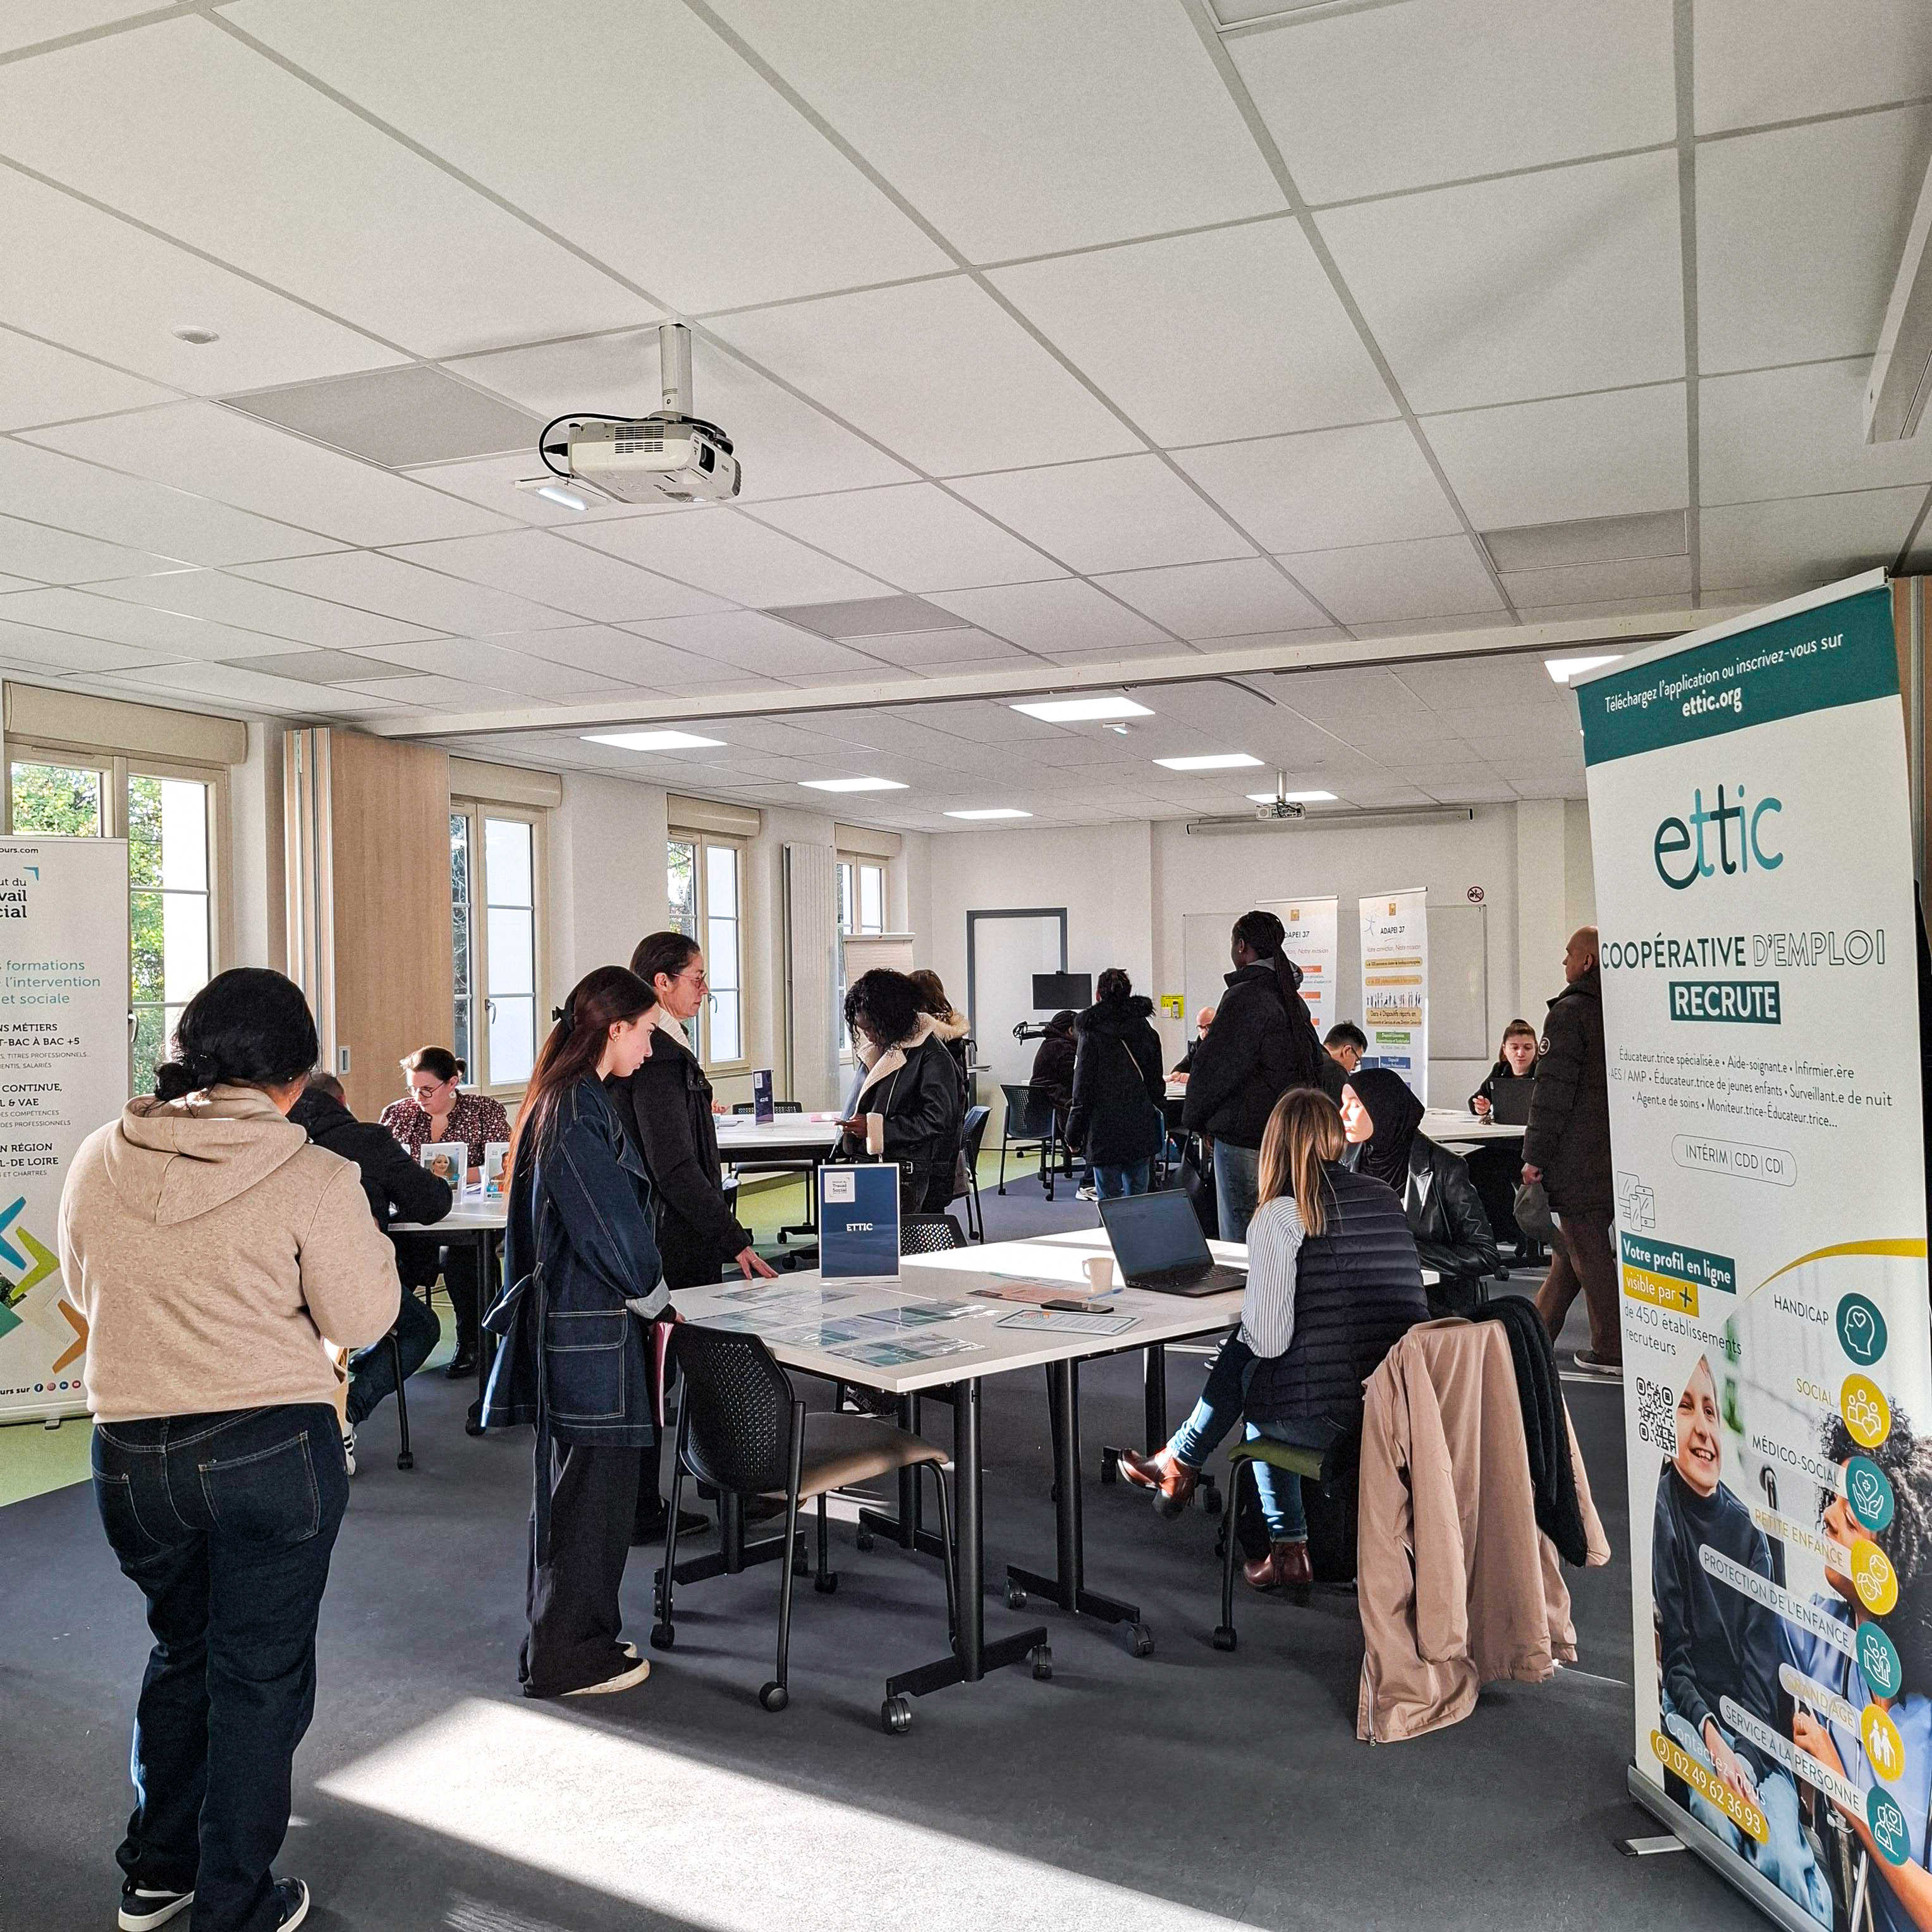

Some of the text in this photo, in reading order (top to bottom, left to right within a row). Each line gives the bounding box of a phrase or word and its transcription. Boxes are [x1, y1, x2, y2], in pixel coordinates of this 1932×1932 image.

[1605, 633, 1843, 712] Téléchargez l'application ou inscrivez-vous sur
[1682, 687, 1742, 716] ettic.org
[1654, 784, 1784, 890] ettic
[12, 877, 27, 886] du
[7, 960, 85, 971] formations
[1601, 929, 1886, 970] COOPÉRATIVE D'EMPLOI
[6, 977, 100, 987] l'intervention
[1, 993, 70, 1004] et sociale
[1675, 985, 1776, 1018] RECRUTE
[12, 1022, 58, 1032] MÉTIERS
[32, 1037, 40, 1046] À
[43, 1037, 64, 1046] BAC
[1619, 1045, 1854, 1079] Éducateur.trice spécialisé.e Aide-soignant.e Infirmier.ère
[2, 1084, 63, 1092] CONTINUE,
[1611, 1068, 1622, 1080] AES
[1628, 1070, 1646, 1082] AMP
[1654, 1068, 1715, 1089] Éducateur.trice
[1716, 1078, 1726, 1090] de
[1727, 1078, 1752, 1095] jeunes
[1754, 1080, 1782, 1096] enfants
[1790, 1084, 1844, 1103] Surveillant.e
[1848, 1089, 1862, 1104] de
[1866, 1092, 1893, 1106] nuit
[1637, 1091, 1666, 1108] Agent.e
[1668, 1094, 1678, 1106] de
[1680, 1096, 1699, 1109] soins
[11, 1142, 52, 1152] RÉGION
[28, 1157, 59, 1166] LOIRE
[1685, 1144, 1783, 1175] INTÉRIM CDD CDI
[846, 1223, 873, 1232] ETTIC
[1623, 1238, 1731, 1287] Votre profil en ligne
[1626, 1272, 1655, 1295] visible
[1658, 1287, 1676, 1304] par
[1774, 1294, 1829, 1326] HANDICAP
[1624, 1301, 1742, 1355] de 450 établissements
[1626, 1328, 1676, 1355] recruteurs
[1796, 1378, 1835, 1407] SOCIAL
[1752, 1434, 1840, 1488] MÉDICO-SOCIAL
[1755, 1508, 1844, 1567] PETITE ENFANCE
[1704, 1551, 1850, 1649] PROTECTION DE L'ENFANCE
[1666, 1712, 1766, 1806] Contactez-nous
[1726, 1704, 1860, 1811] SERVICE À LA PERSONNE
[1674, 1751, 1761, 1835] 02 49 62 36 93
